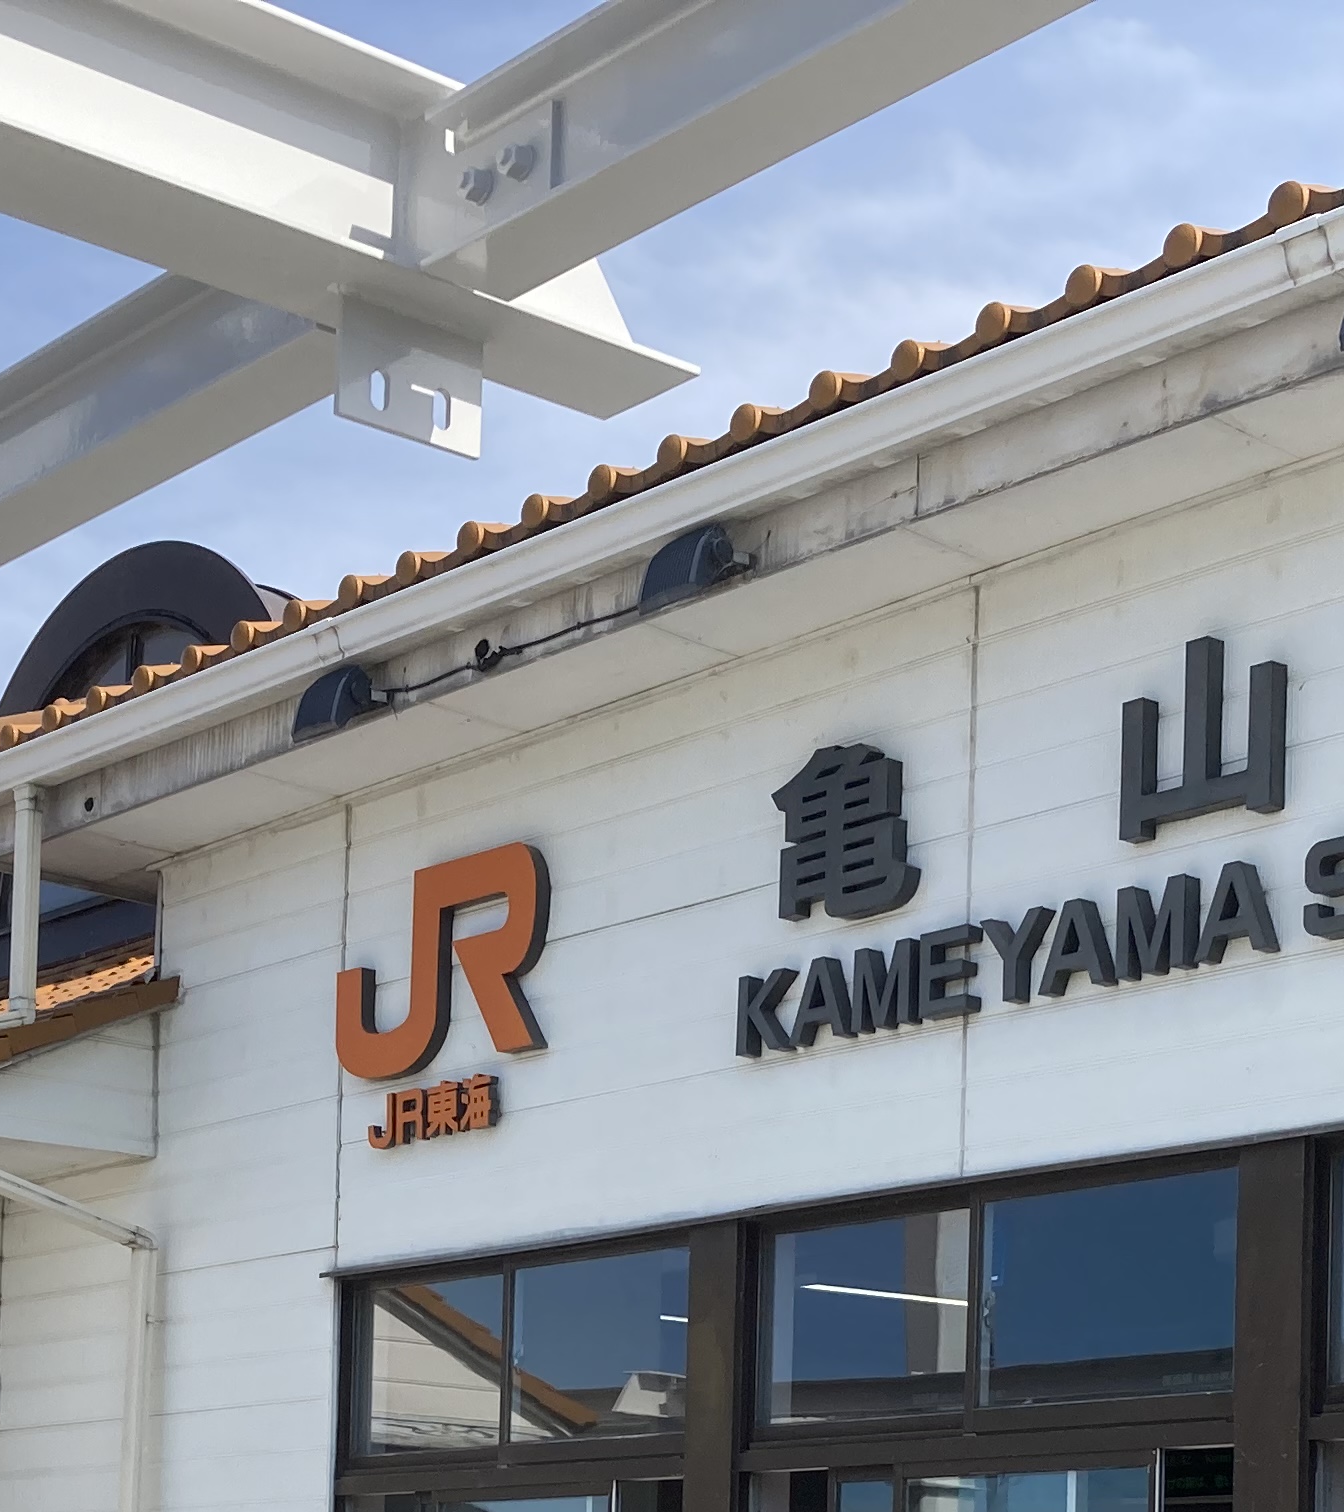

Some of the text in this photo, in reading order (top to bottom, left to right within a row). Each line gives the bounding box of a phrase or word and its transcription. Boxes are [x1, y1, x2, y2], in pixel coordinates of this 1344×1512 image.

[335, 841, 551, 1080] JR
[735, 860, 1281, 1058] KAMEYAMA
[367, 1073, 501, 1150] JR東海
